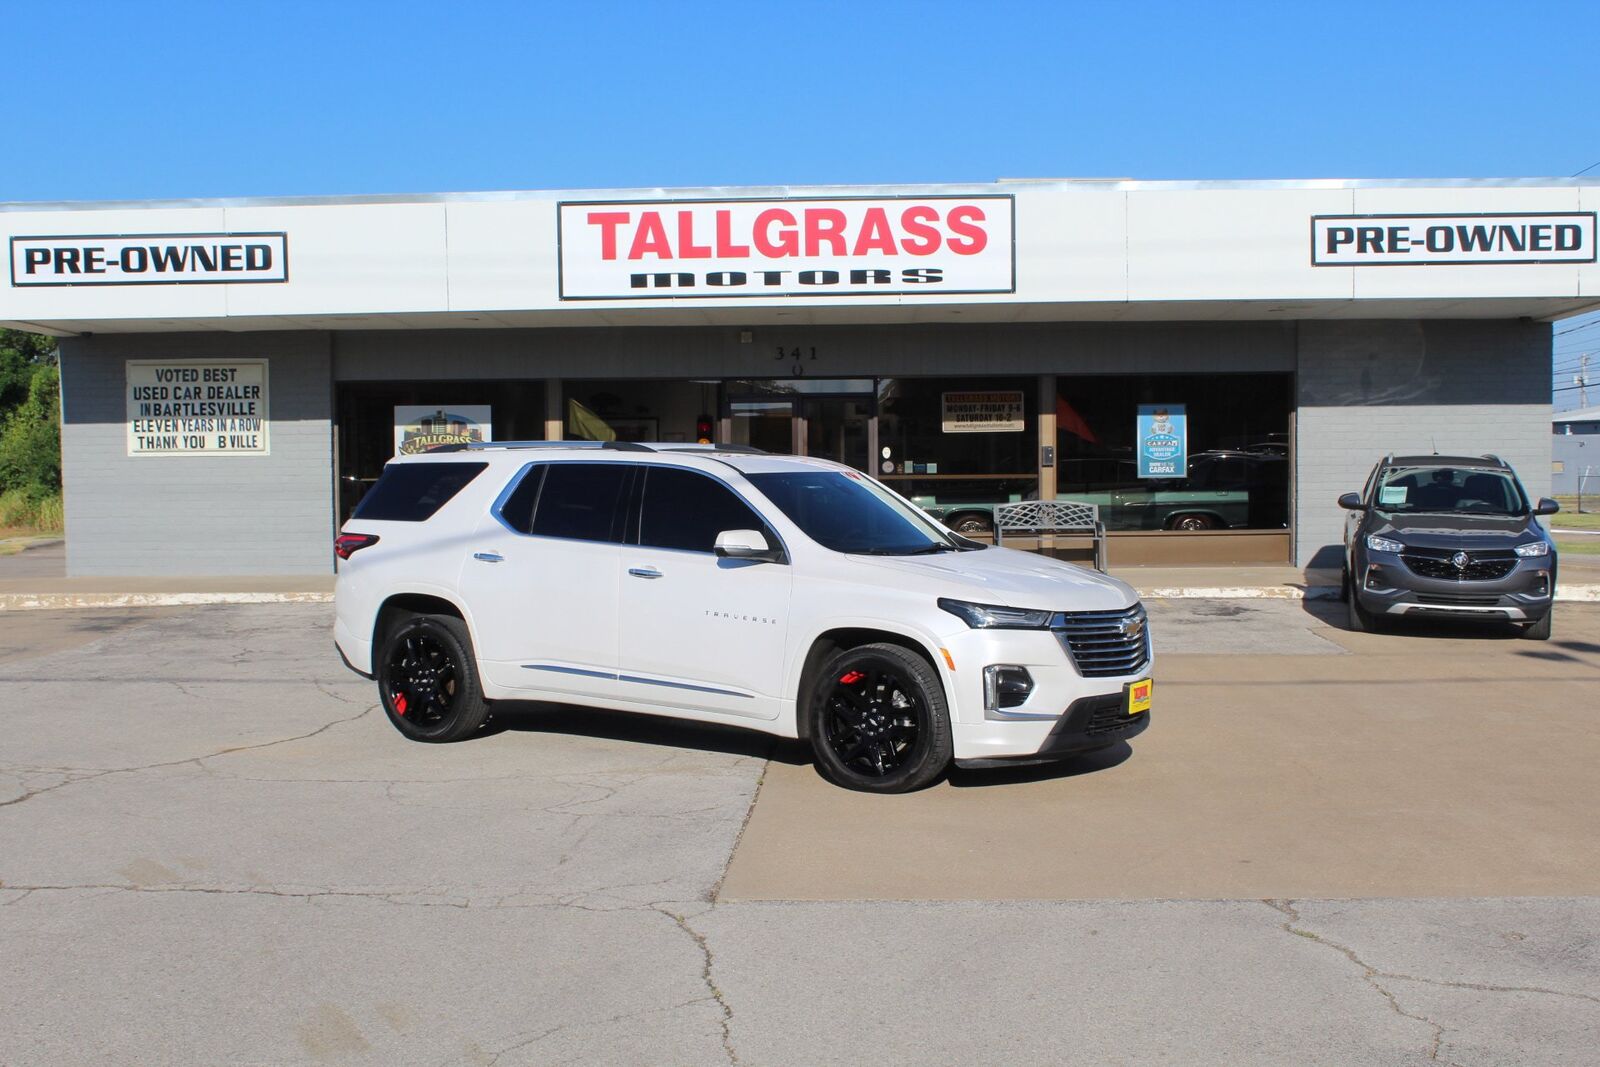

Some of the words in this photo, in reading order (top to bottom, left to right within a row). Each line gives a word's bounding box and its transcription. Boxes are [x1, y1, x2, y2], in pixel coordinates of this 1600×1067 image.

[587, 205, 988, 261] TALLGRASS
[1326, 224, 1582, 254] PRE-OWNED
[25, 244, 272, 274] PRE-OWNED
[630, 268, 943, 289] MOTORS
[156, 368, 199, 382] VOTED
[204, 368, 237, 382] BEST
[134, 386, 168, 400] USED
[173, 386, 201, 400] CAR
[208, 386, 260, 399] DEALER
[140, 403, 151, 416] IN
[154, 402, 255, 416] BARTLESVILLE
[956, 413, 992, 422] SATURDAY
[134, 419, 178, 432] ELEVEN
[182, 418, 214, 432] YEARS
[216, 418, 226, 432] IN
[230, 418, 236, 432] A
[239, 418, 261, 432] ROW
[138, 436, 178, 449] THANK
[182, 436, 205, 448] YOU
[218, 436, 226, 448] B
[230, 435, 258, 448] VILLE
[414, 434, 472, 448] TALLGRASS
[705, 610, 777, 625] TRAVERSE
